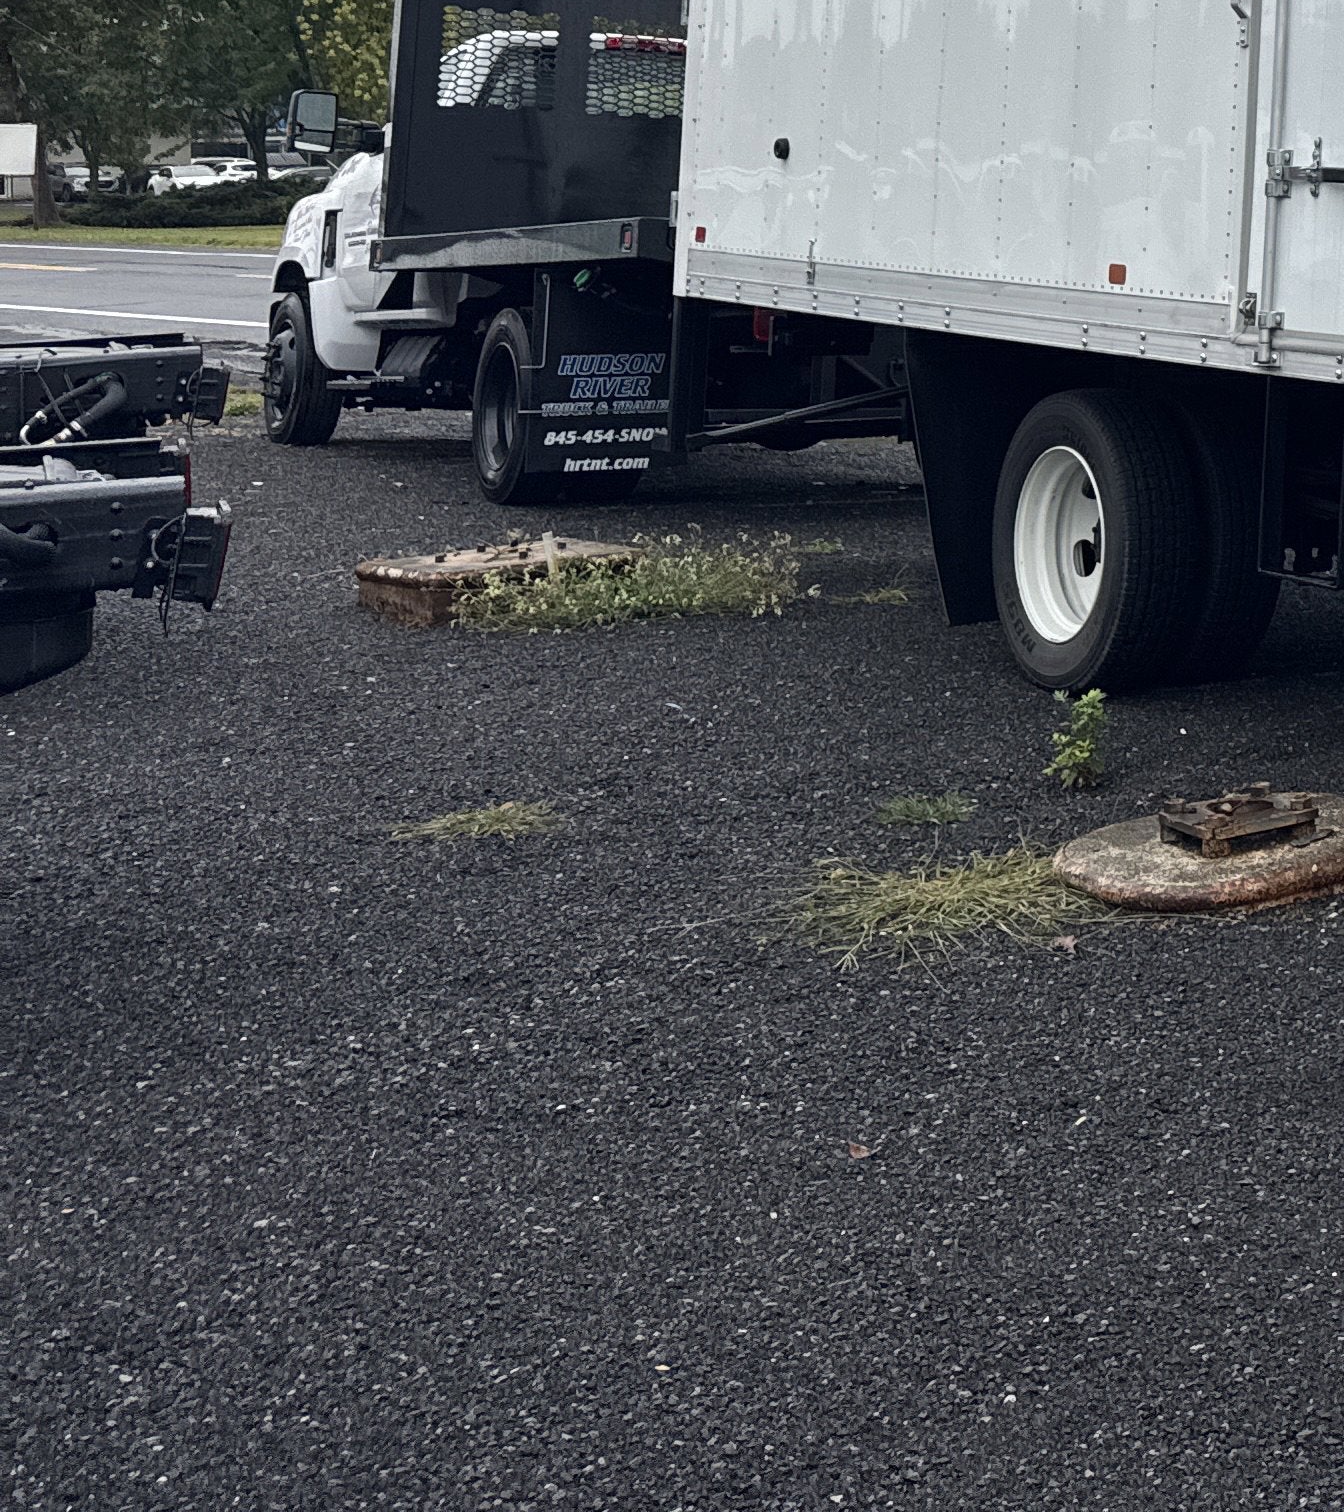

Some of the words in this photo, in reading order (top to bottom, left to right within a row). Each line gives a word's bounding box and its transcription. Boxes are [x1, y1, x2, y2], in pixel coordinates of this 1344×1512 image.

[557, 352, 666, 376] HUDSON
[570, 375, 652, 399] RIVER
[541, 401, 593, 418] TRUCK
[595, 401, 609, 415] &
[563, 456, 650, 473] hrtnt.com
